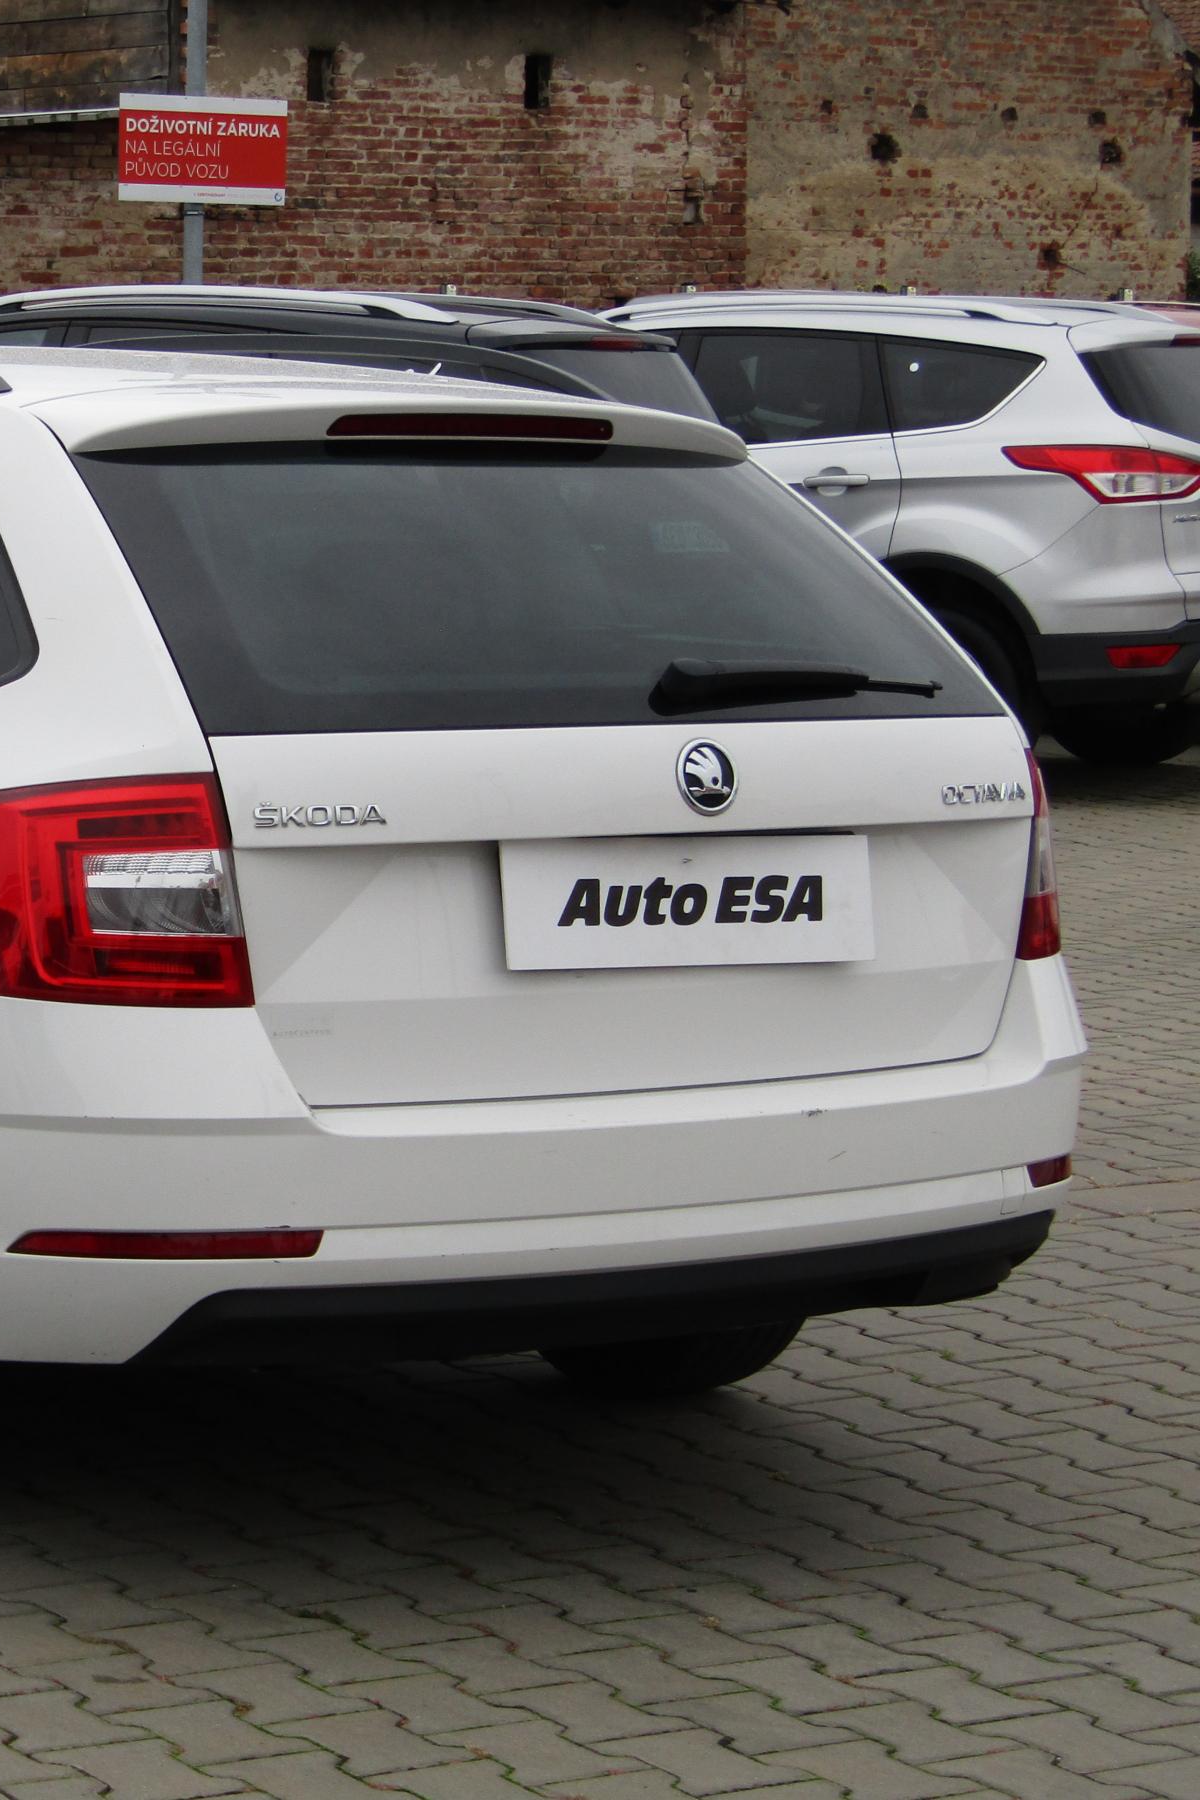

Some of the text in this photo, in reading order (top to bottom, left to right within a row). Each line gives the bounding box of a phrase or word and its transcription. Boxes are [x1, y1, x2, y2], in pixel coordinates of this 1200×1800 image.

[125, 115, 281, 138] DOŽIVOTNÍ ZÁRUKA
[125, 139, 222, 157] NA LEGÁLNÍ
[125, 157, 229, 179] PŮVOD VOZU
[941, 781, 1026, 806] OCTAVIA
[253, 802, 388, 829] ŠKODA
[557, 874, 824, 927] Auto ESA
